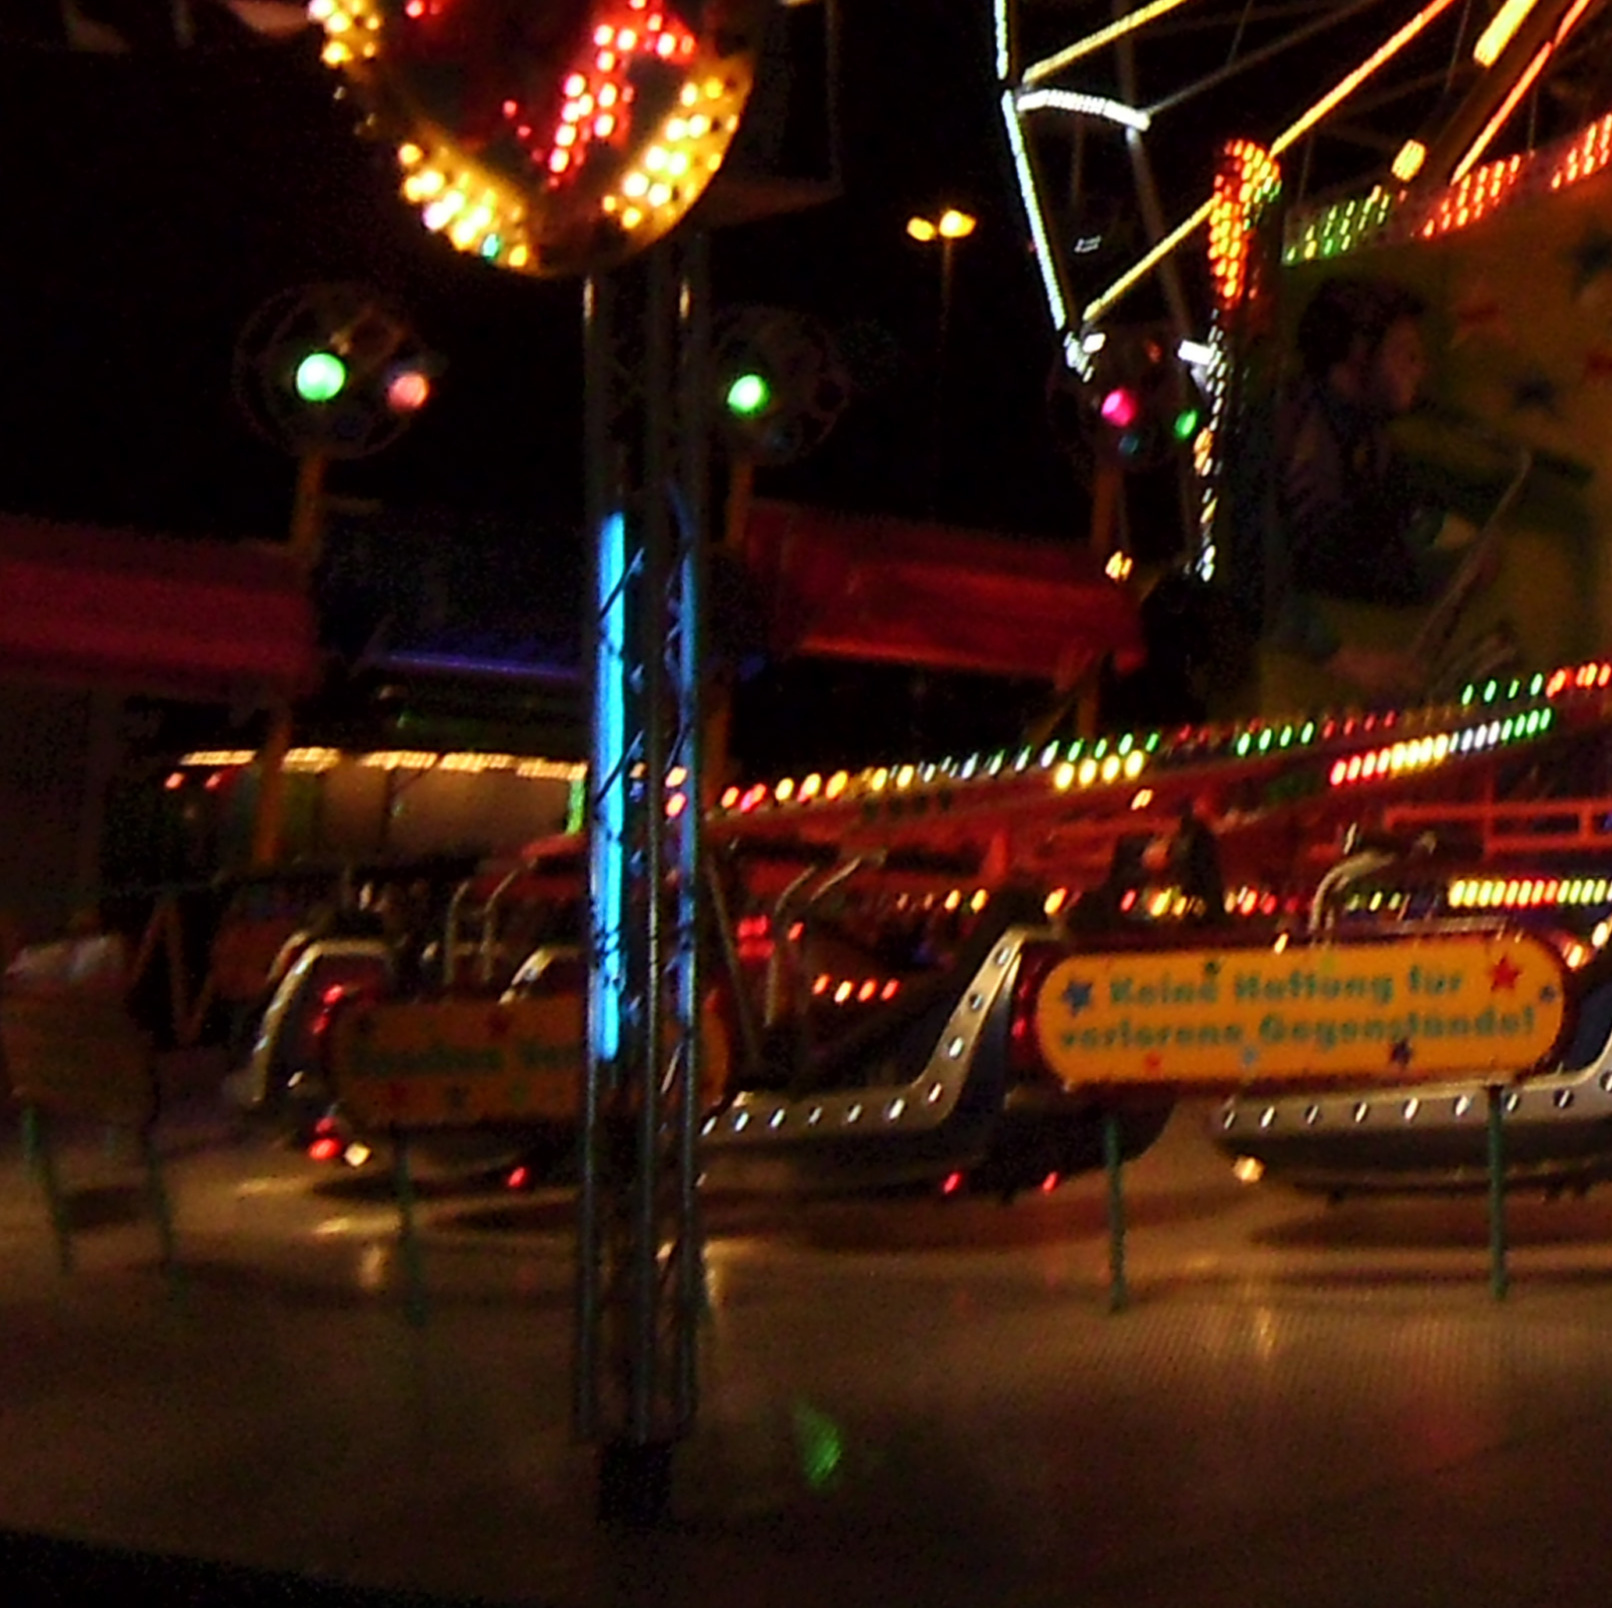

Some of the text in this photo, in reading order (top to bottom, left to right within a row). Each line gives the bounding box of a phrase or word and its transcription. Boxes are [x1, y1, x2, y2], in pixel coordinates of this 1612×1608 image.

[1109, 972, 1218, 1003] Keine
[1234, 968, 1393, 1004] Haftung
[1061, 1018, 1243, 1048] verlorene
